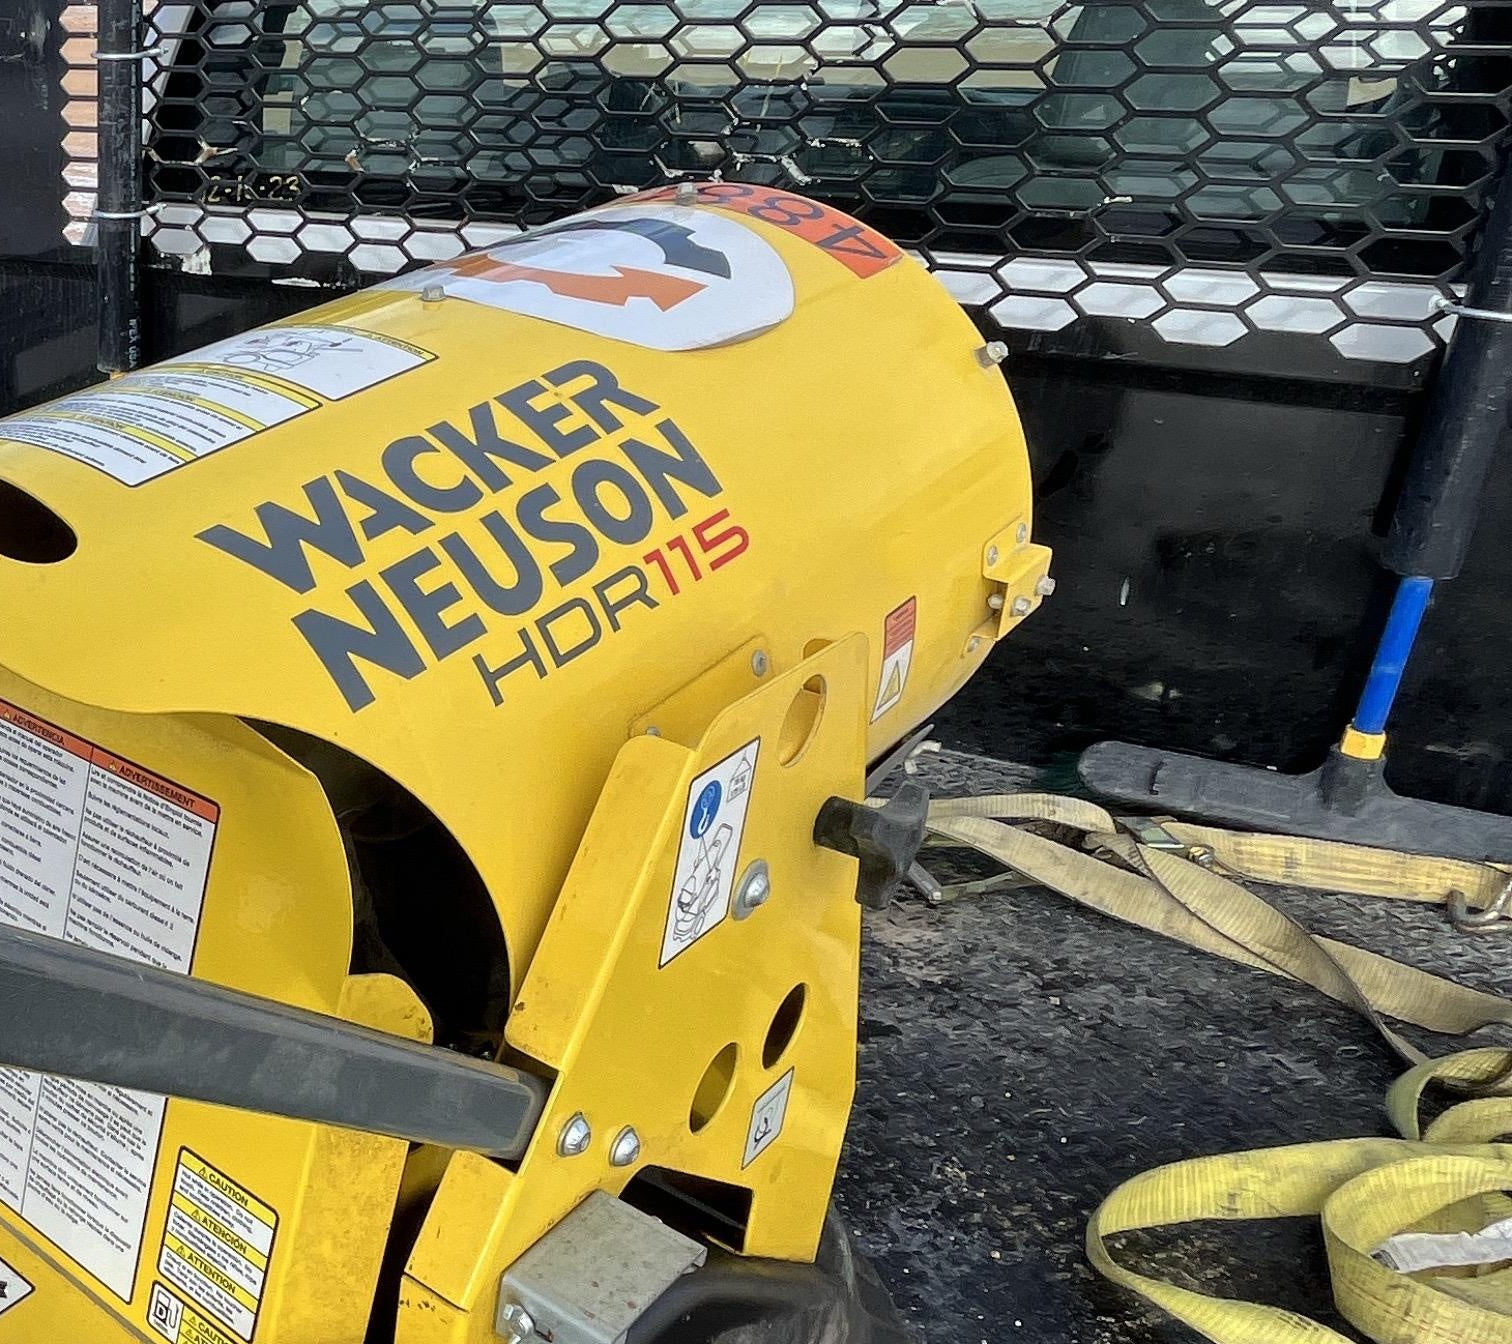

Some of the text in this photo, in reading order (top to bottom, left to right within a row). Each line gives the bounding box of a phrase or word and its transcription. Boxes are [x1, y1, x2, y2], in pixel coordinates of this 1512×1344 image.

[194, 359, 660, 595] WACKER
[291, 417, 724, 713] NEUSON
[472, 508, 750, 707] HDR115
[201, 1211, 247, 1255] ATENCIÓN
[208, 1171, 248, 1208] CAUTION
